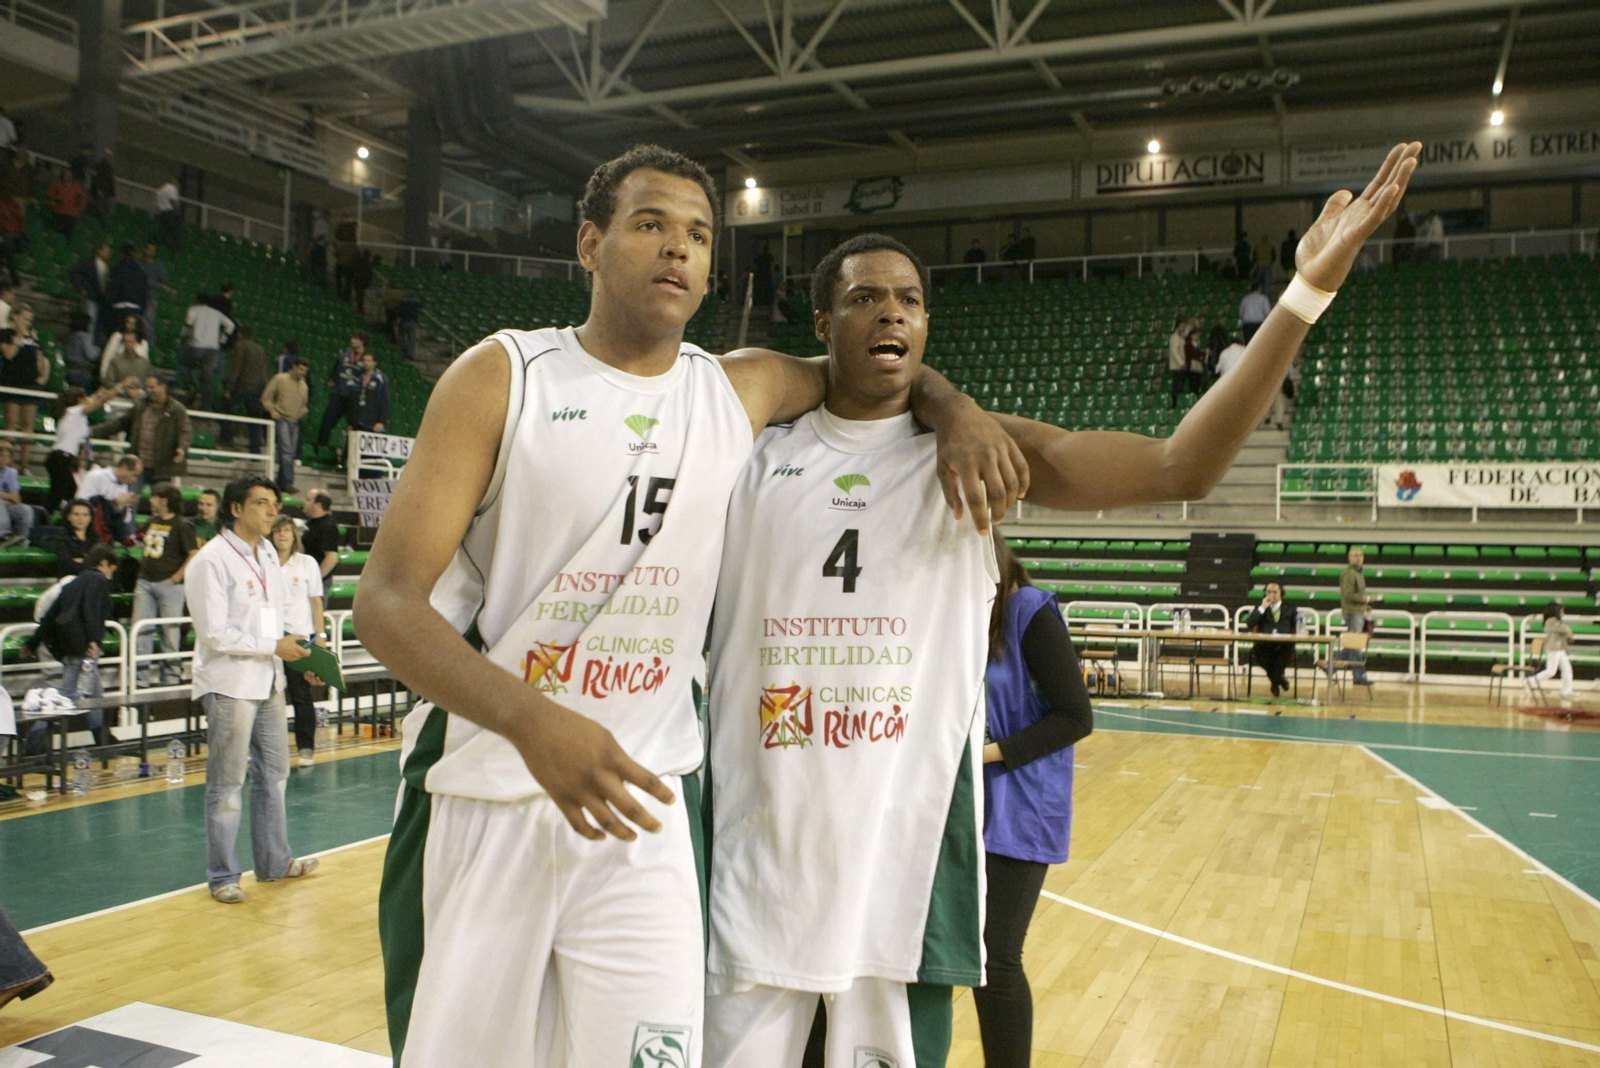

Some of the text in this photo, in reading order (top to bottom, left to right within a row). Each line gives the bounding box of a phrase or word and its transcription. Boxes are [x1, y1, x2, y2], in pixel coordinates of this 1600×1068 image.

[1493, 138, 1517, 160] DE
[360, 435, 388, 454] ORTIZ
[832, 497, 866, 509] Unicaja
[1510, 487, 1540, 503] DE
[621, 475, 676, 545] 15
[822, 529, 863, 593] 4
[552, 566, 680, 594] INSTIUTO
[763, 617, 907, 637] INSTITUTO
[586, 636, 675, 655] CLINICAS
[759, 646, 913, 666] FERTILIDAD
[819, 686, 913, 703] CLINICAS
